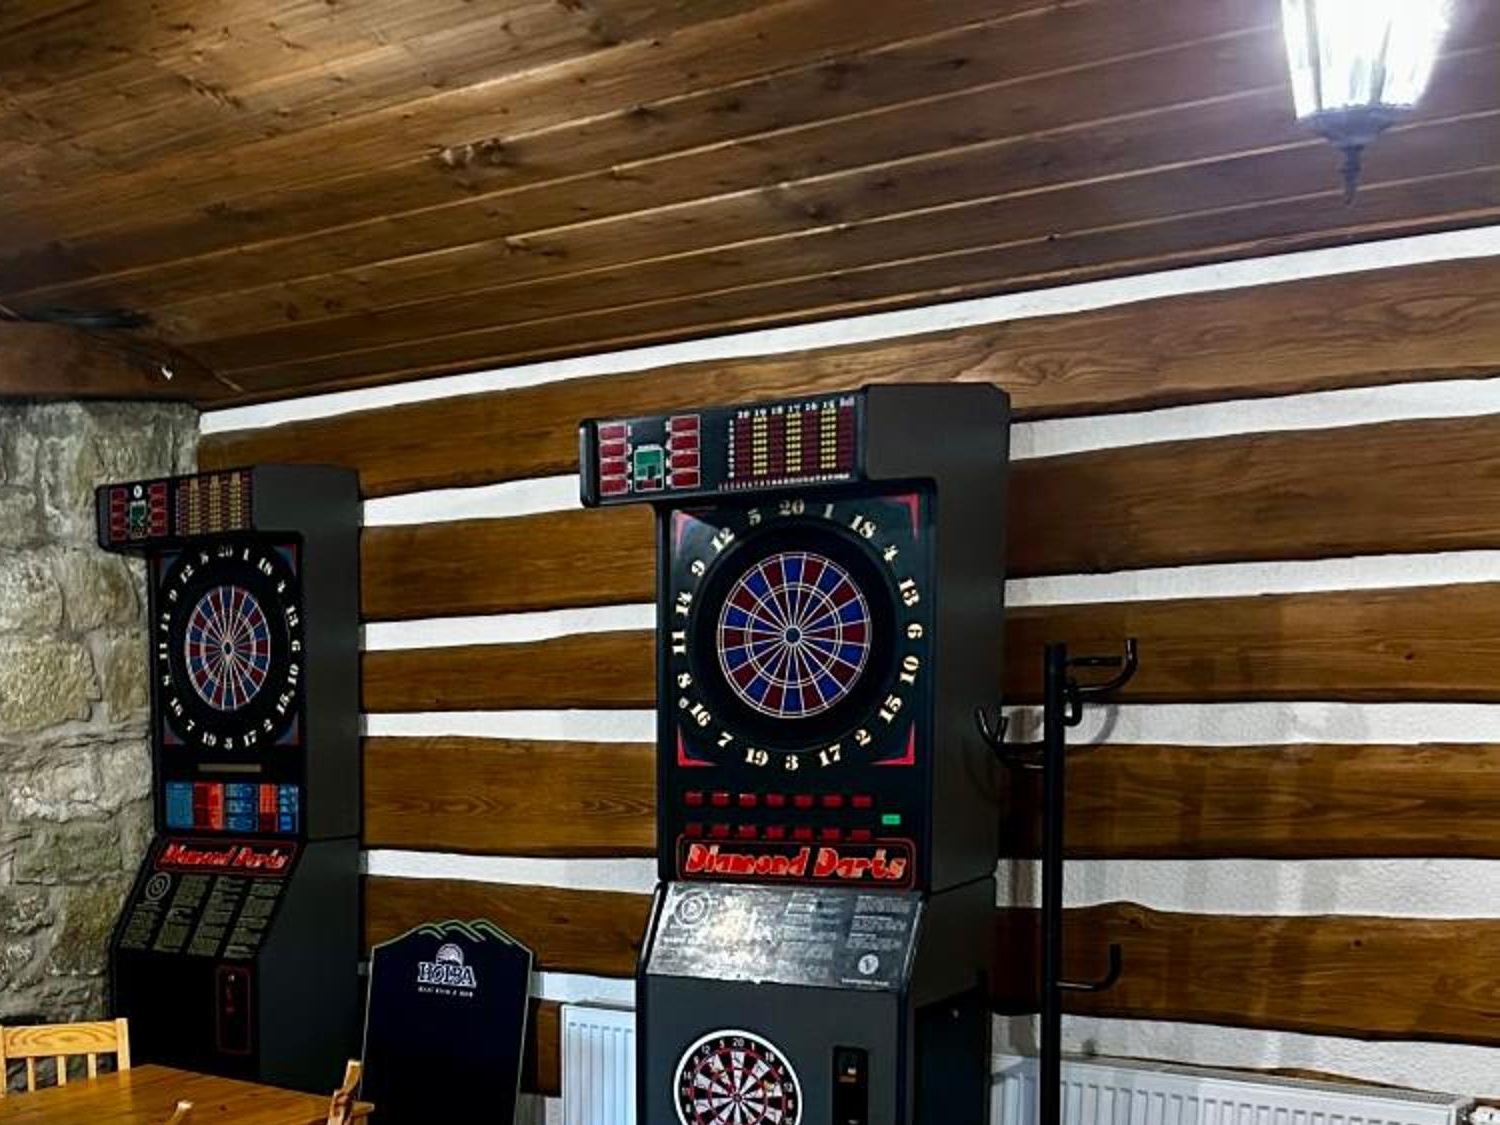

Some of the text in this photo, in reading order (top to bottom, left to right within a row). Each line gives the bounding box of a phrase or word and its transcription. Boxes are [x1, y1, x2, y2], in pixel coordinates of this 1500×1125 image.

[779, 499, 805, 516] 20
[823, 503, 835, 520] 1
[748, 509, 762, 526] 5
[849, 515, 877, 540] 18
[710, 527, 735, 553] 12
[883, 544, 900, 562] 4
[691, 560, 706, 577] 9
[899, 578, 920, 608] 13
[907, 622, 923, 639] 6
[671, 630, 687, 656] 11
[900, 655, 920, 686] 10
[677, 672, 692, 689] 8
[690, 702, 712, 728] 16
[878, 693, 903, 724] 15
[717, 731, 734, 748] 7
[855, 729, 872, 747] 2
[745, 748, 769, 767] 19
[785, 754, 799, 771] 3
[819, 743, 841, 768] 17
[685, 843, 907, 879] Diamond Darts
